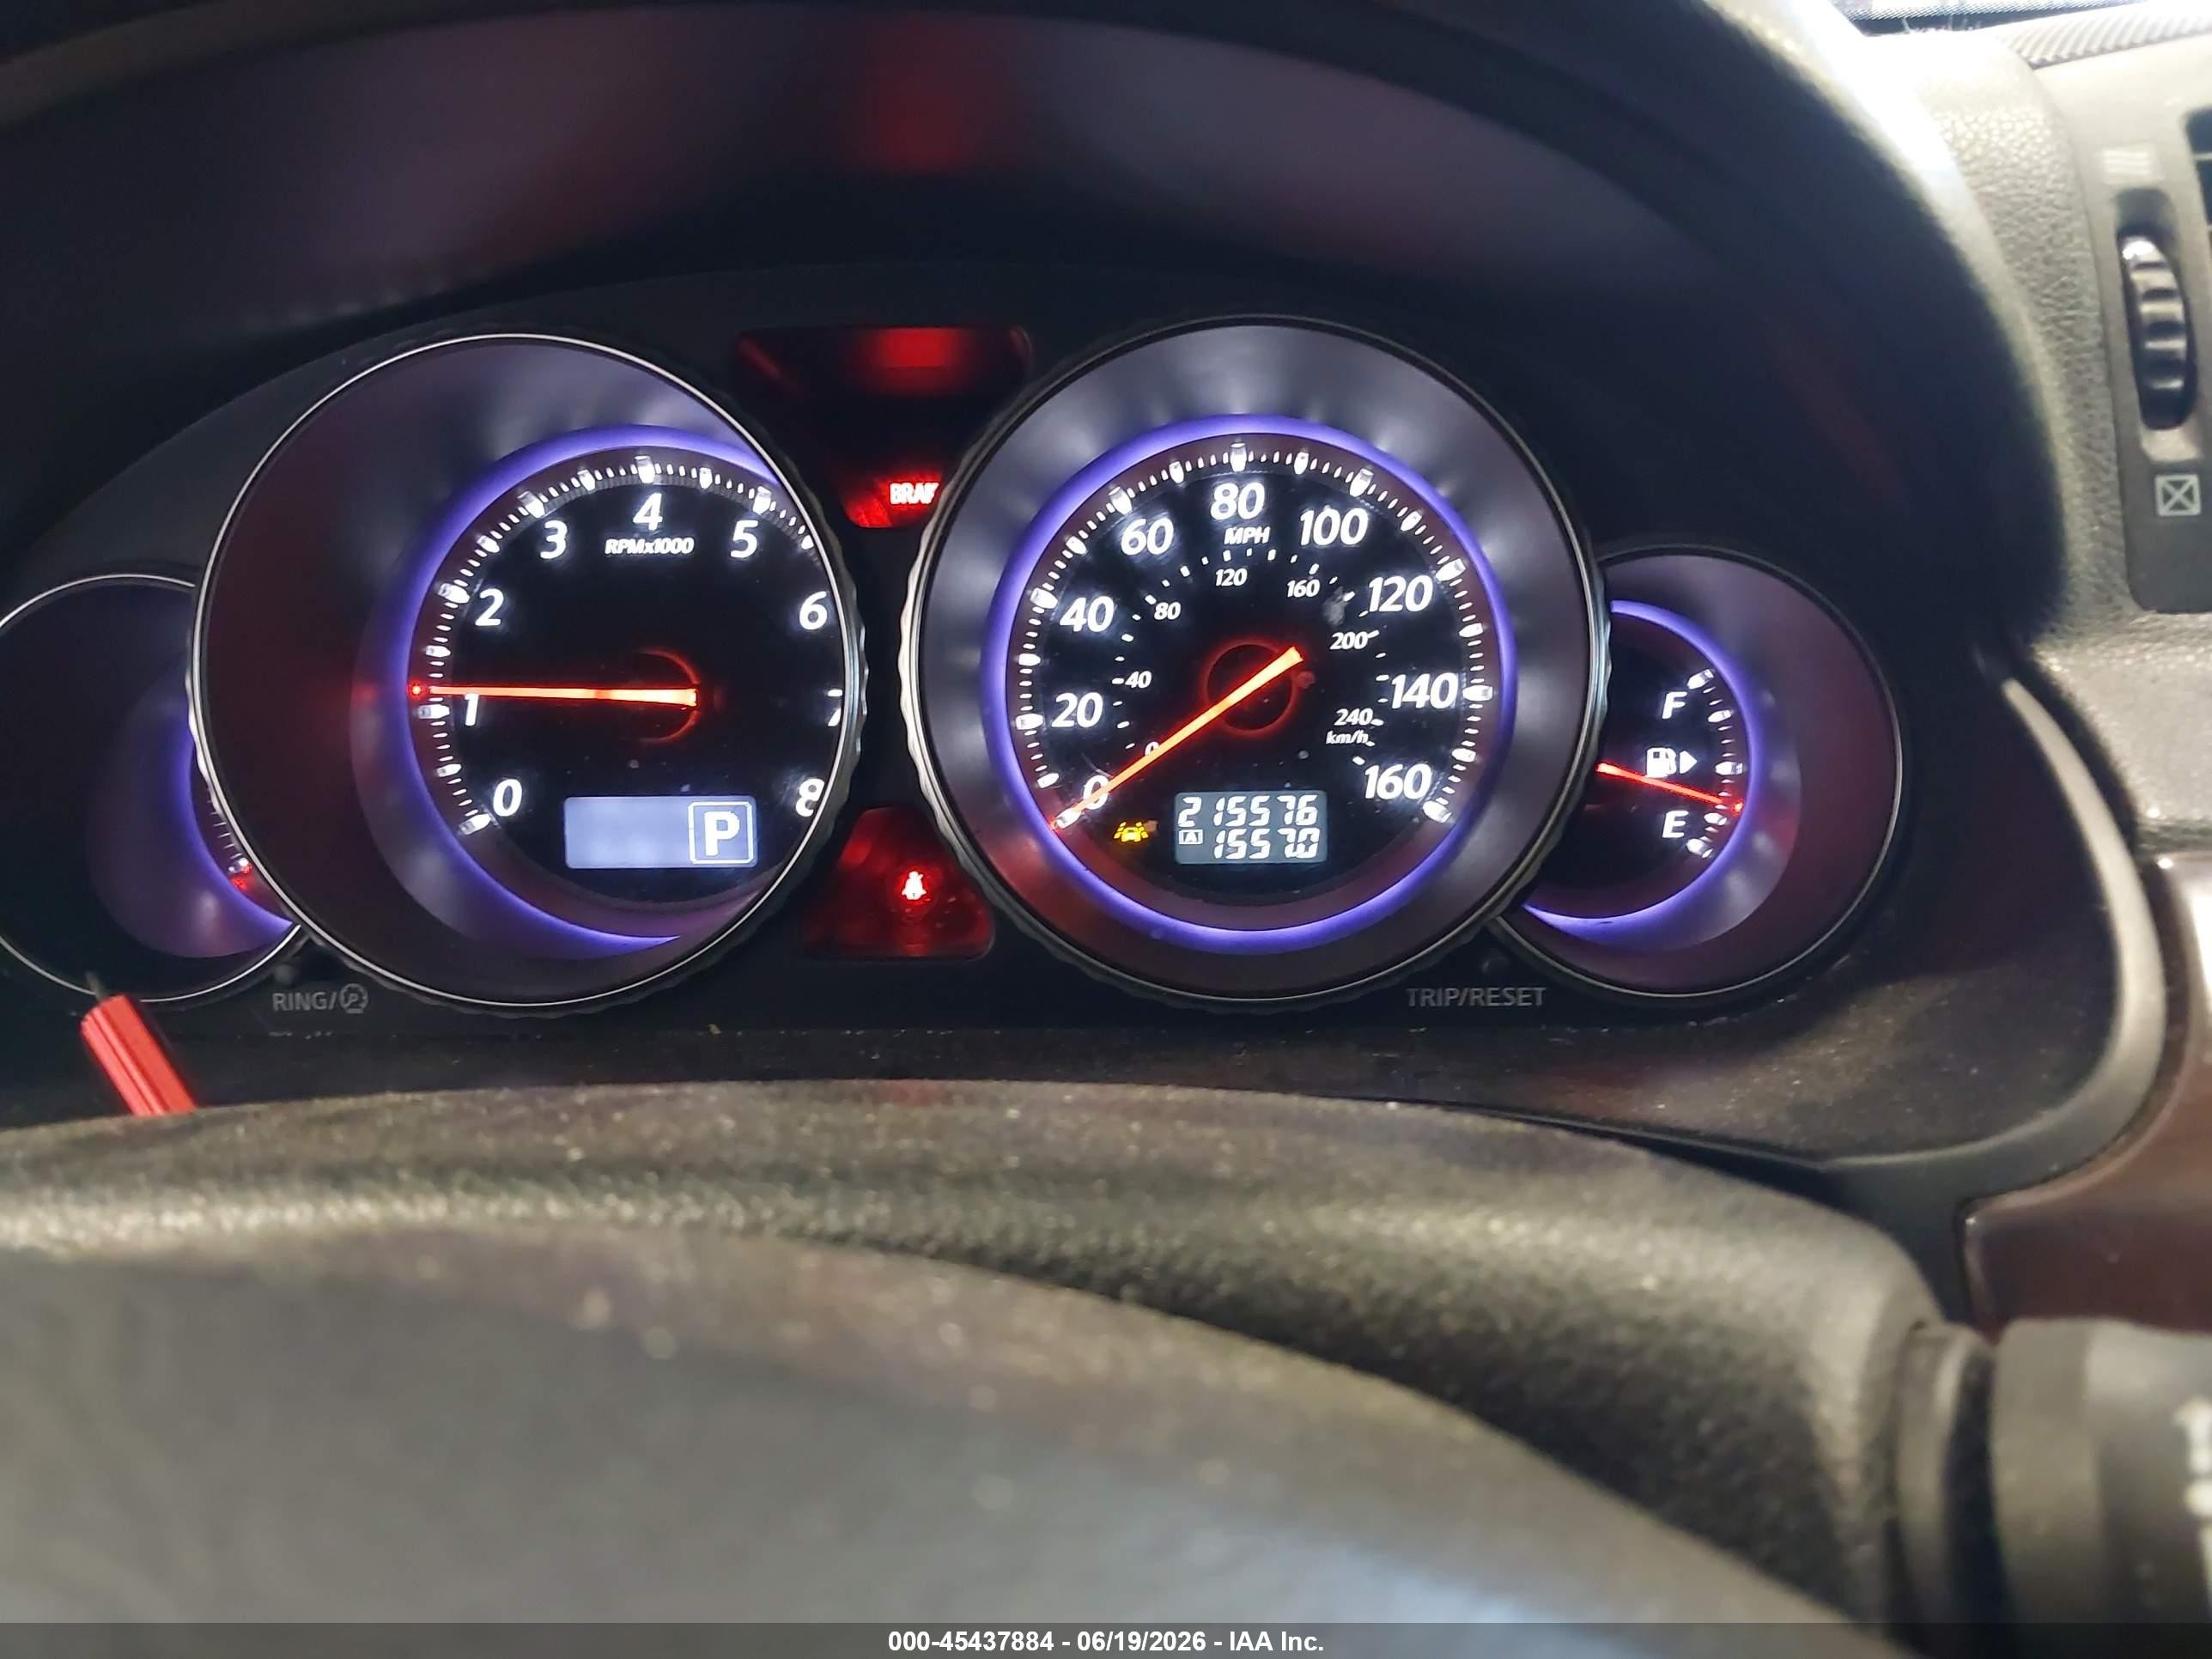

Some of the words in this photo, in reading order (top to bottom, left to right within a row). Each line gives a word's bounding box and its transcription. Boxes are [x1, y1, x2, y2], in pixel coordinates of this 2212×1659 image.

[633, 492, 663, 531] 4
[1211, 482, 1266, 520] 80
[540, 520, 568, 559] 3
[730, 520, 759, 558] 5
[1121, 518, 1174, 555] 60
[1224, 526, 1270, 545] MPH
[1299, 508, 1369, 545] 100
[1215, 568, 1248, 586] 120
[1287, 579, 1321, 598] 160
[1368, 575, 1433, 612] 120
[475, 588, 504, 627] 2
[799, 591, 828, 630] 6
[1060, 596, 1115, 632] 40
[1153, 601, 1182, 620] 80
[1330, 631, 1369, 650] 200
[1125, 671, 1152, 688] 40
[1391, 672, 1458, 708] 140
[465, 693, 480, 726] 1
[1051, 692, 1103, 727] 20
[1334, 708, 1374, 726] 240
[1662, 691, 1686, 719] F
[1326, 730, 1370, 745] km/h
[493, 779, 522, 817] 0
[1083, 775, 1109, 810] 0
[1364, 763, 1433, 799] 160
[705, 811, 740, 856] P
[1662, 810, 1689, 838] E
[1407, 988, 1547, 1007] TRIP/RESET
